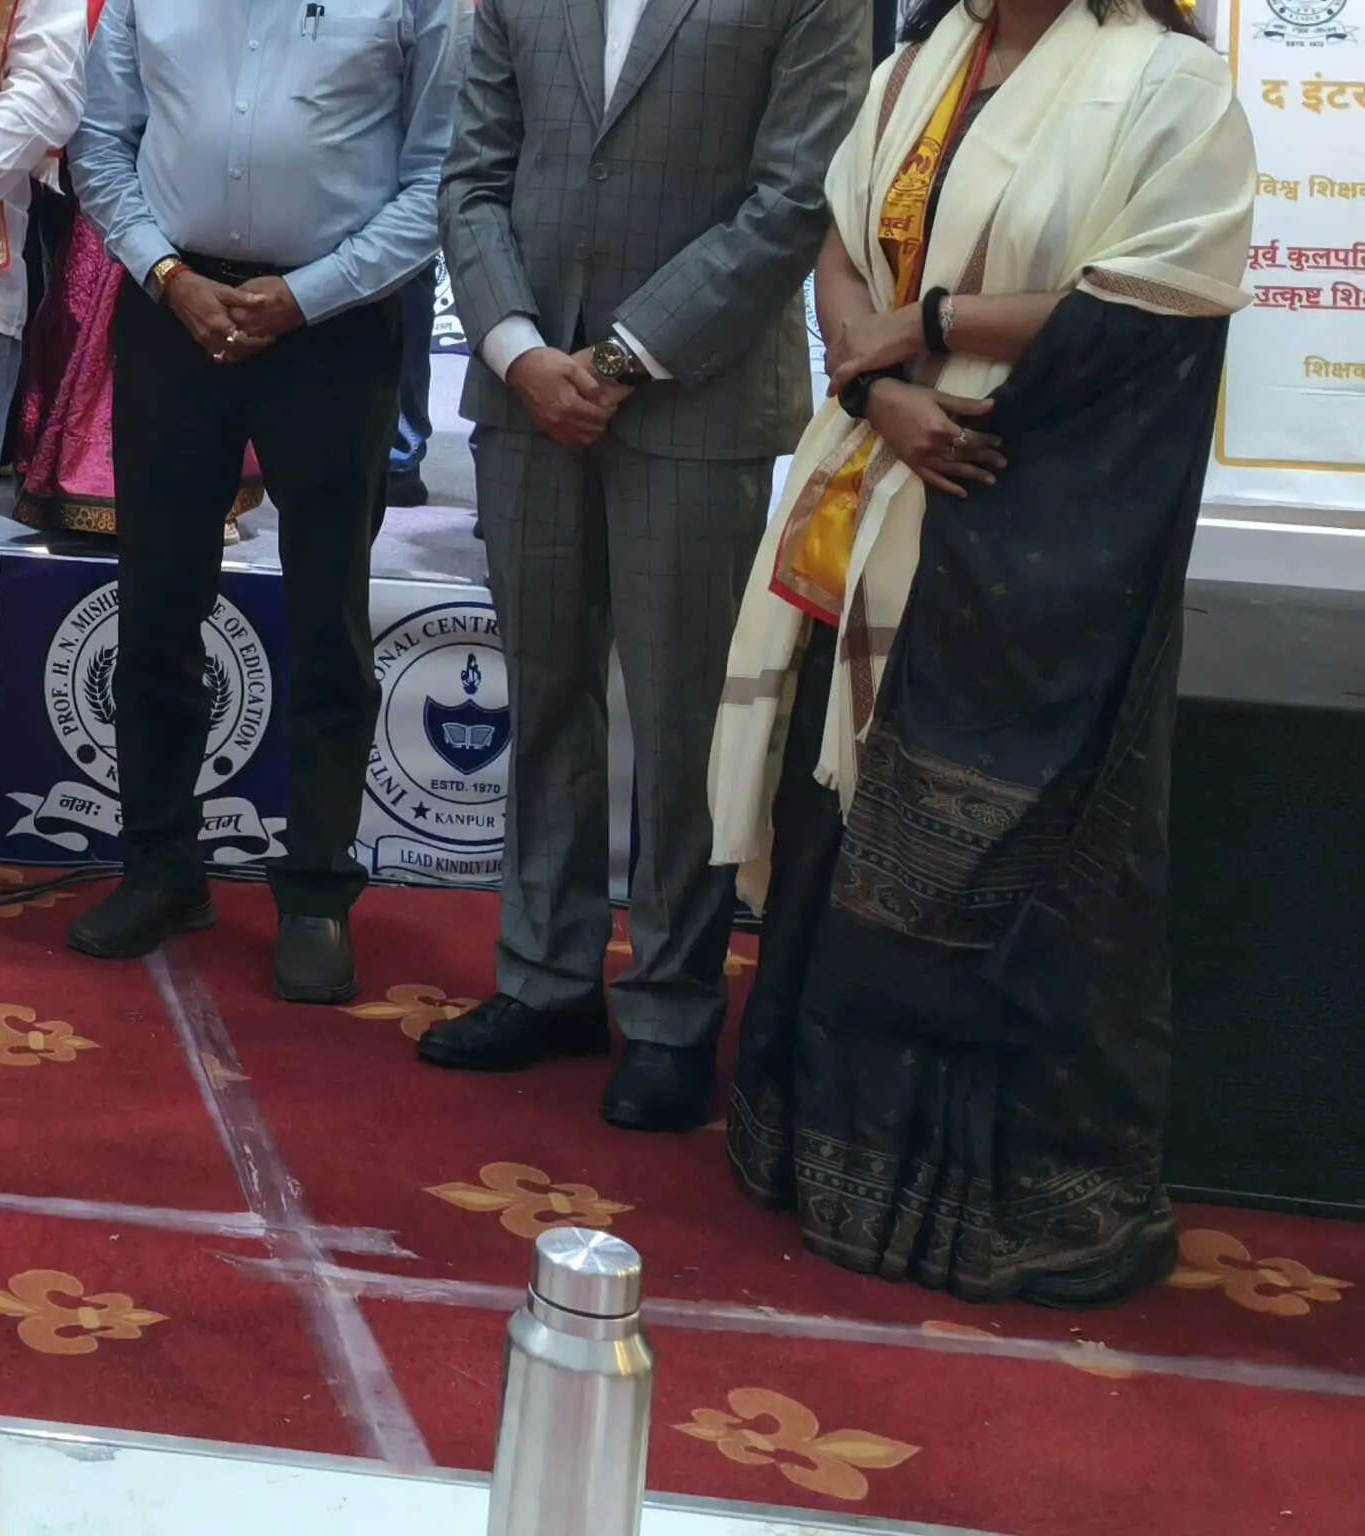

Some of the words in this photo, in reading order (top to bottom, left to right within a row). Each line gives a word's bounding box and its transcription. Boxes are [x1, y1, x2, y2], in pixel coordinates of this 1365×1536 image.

[1261, 79, 1287, 110] द
[223, 616, 247, 641] OF
[234, 640, 265, 751] EDUCATION
[431, 780, 469, 791] ESTD.
[472, 782, 501, 794] 1970
[59, 794, 101, 816] नमः
[435, 812, 495, 828] KANPUR
[401, 849, 432, 868] LEAD
[435, 859, 487, 874] KINDLY
